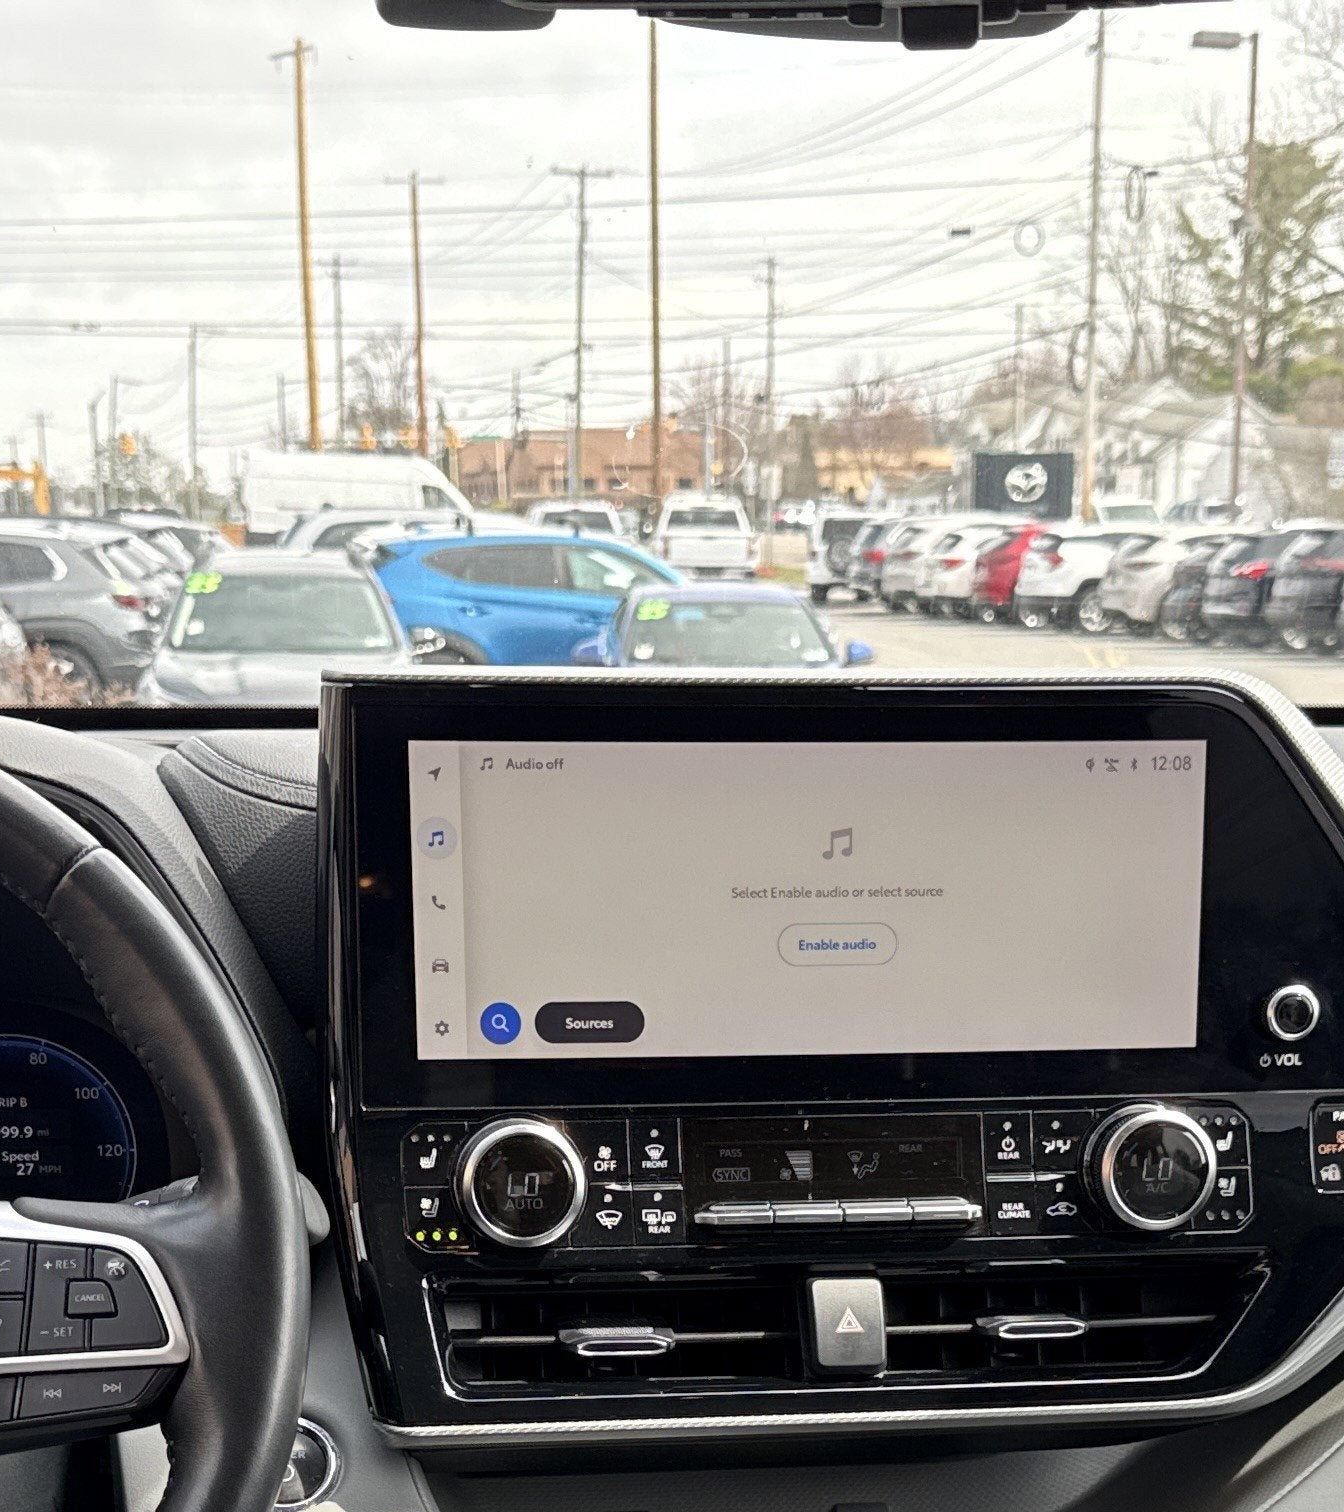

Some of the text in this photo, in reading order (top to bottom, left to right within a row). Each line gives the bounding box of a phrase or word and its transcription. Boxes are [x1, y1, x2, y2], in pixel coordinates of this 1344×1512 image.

[506, 757, 565, 770] Audio off
[1151, 755, 1192, 771] 12:08
[731, 885, 944, 899] Select Enable audio or select source
[798, 938, 877, 951] Enable audio
[565, 1017, 614, 1030] Sources
[29, 1052, 48, 1065] 80
[1274, 1053, 1303, 1067] VOL
[74, 1087, 100, 1100] 100
[19, 1097, 28, 1108] B
[97, 1144, 123, 1157] 120
[719, 1149, 742, 1158] PASS
[997, 1151, 1020, 1160] REAR
[1317, 1143, 1338, 1155] OFF
[1, 1151, 40, 1164] Speed
[16, 1163, 62, 1176] 27 MPH
[594, 1160, 617, 1173] OFF
[642, 1160, 668, 1169] FRONT
[716, 1168, 748, 1181] SYNC
[1145, 1181, 1169, 1194] A/C
[505, 1198, 544, 1210] AUTO
[1002, 1202, 1024, 1211] REAR
[997, 1210, 1031, 1219] CLIMATE
[648, 1224, 671, 1233] REAR
[55, 1259, 77, 1270] RES
[74, 1293, 106, 1303] CANCEL
[53, 1326, 74, 1338] SET
